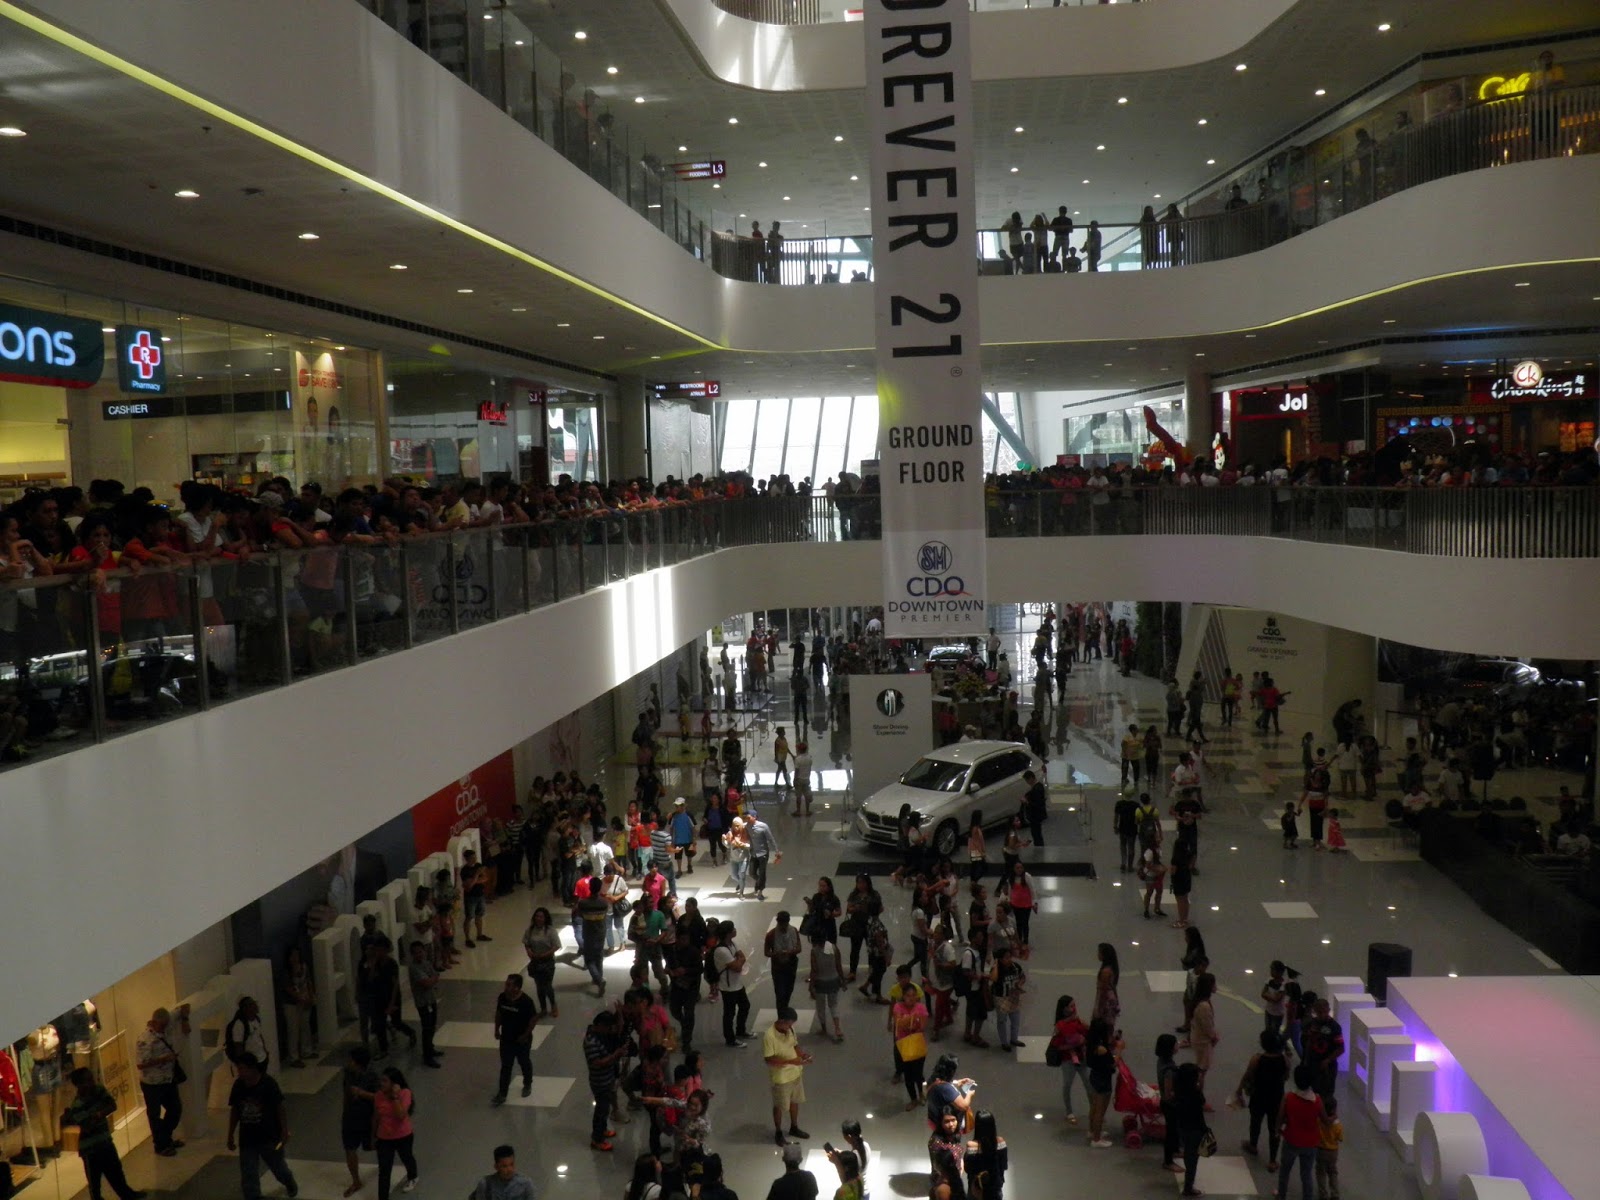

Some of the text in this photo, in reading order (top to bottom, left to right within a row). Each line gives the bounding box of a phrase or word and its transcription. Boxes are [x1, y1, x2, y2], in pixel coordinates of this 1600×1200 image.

[712, 164, 724, 174] L3
[890, 292, 963, 359] 21
[131, 379, 161, 392] Pharmacy
[708, 384, 719, 394] L2
[108, 403, 148, 416] CASHIER
[888, 424, 973, 449] GROUND
[899, 460, 965, 484] FLOOR
[906, 576, 966, 597] CDO
[888, 600, 984, 613] DOWNTOWN
[901, 614, 972, 623] PREMIER
